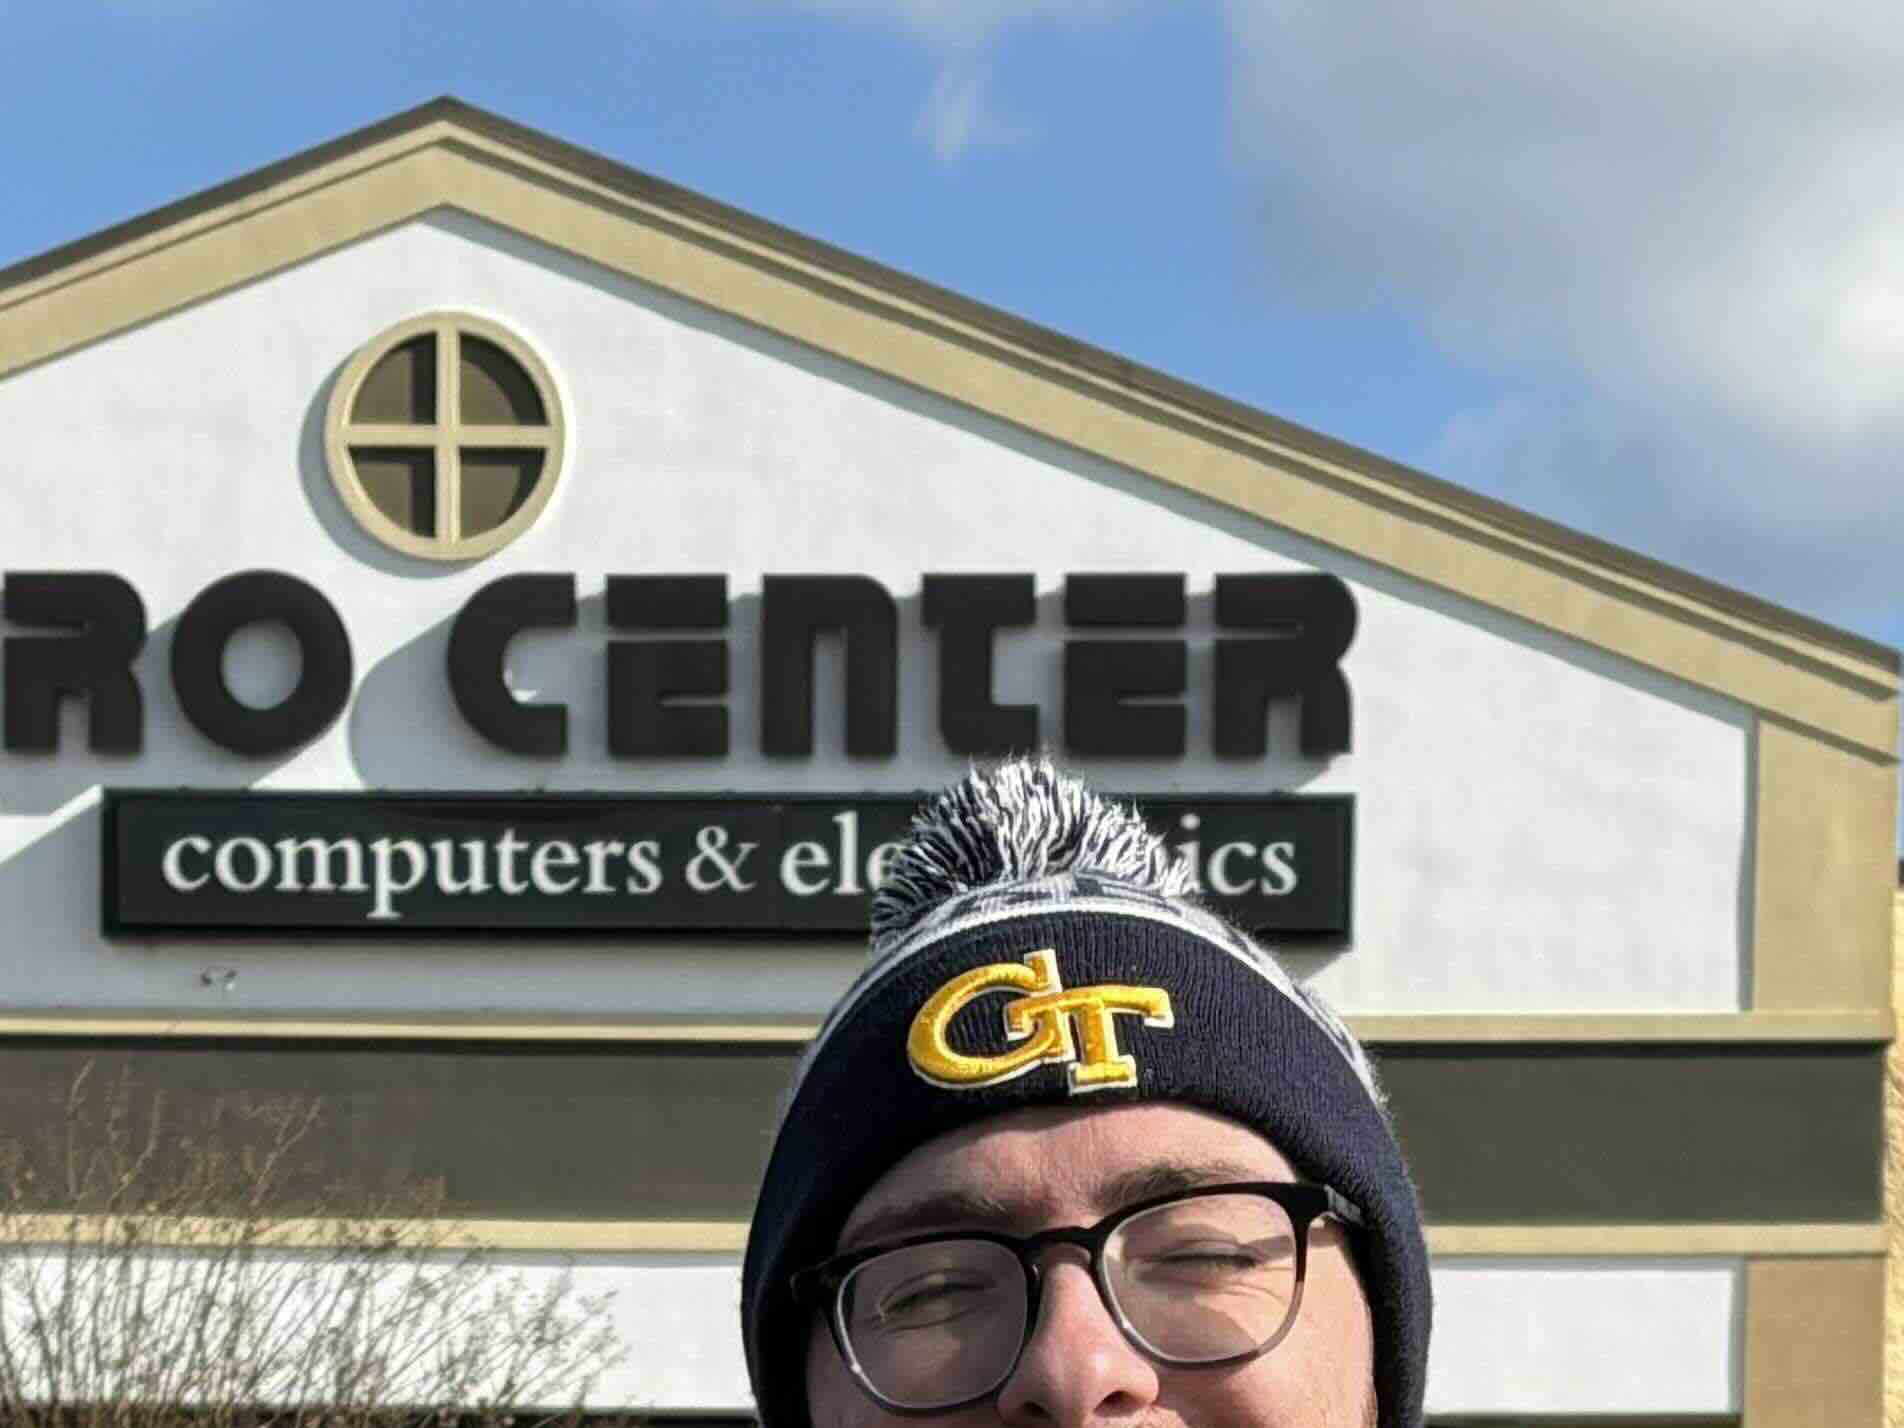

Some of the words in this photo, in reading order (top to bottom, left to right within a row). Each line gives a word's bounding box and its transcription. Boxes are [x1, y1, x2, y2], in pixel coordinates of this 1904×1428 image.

[446, 570, 1358, 760] CENTER
[161, 827, 663, 919] computers
[685, 824, 758, 893] &
[779, 810, 1298, 896] eleics
[906, 949, 1175, 1094] GT
